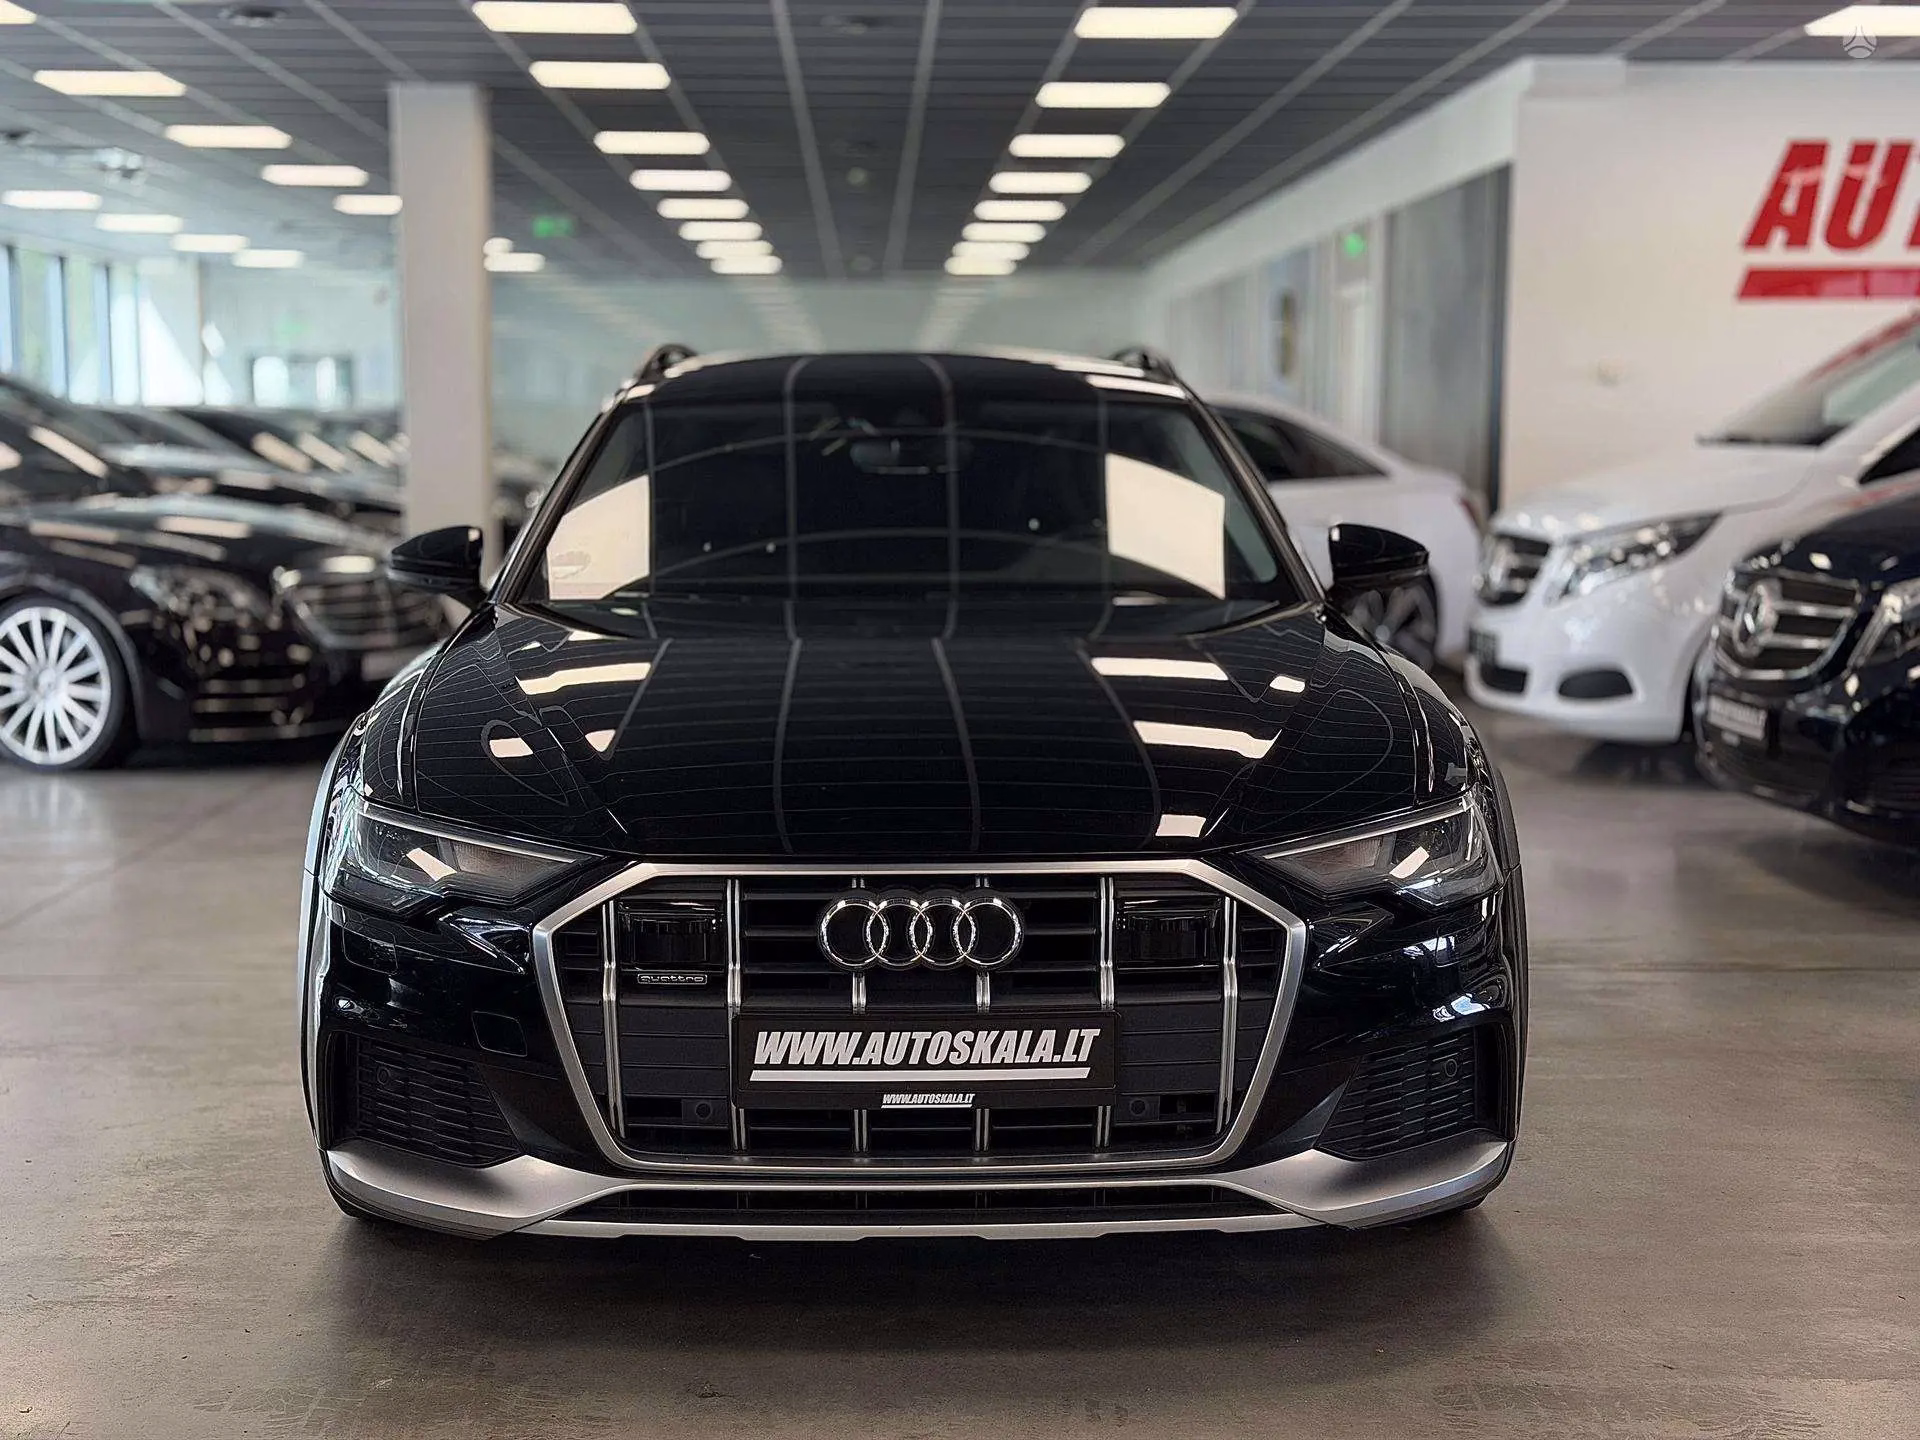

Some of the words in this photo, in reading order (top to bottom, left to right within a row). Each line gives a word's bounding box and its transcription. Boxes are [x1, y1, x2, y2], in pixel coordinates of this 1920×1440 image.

[1743, 139, 1920, 251] AU
[640, 975, 704, 983] quattro
[753, 1028, 1101, 1066] WWW.AUTOSKALA.LT
[882, 1093, 976, 1104] WWW.AUTOSKALA.LT
